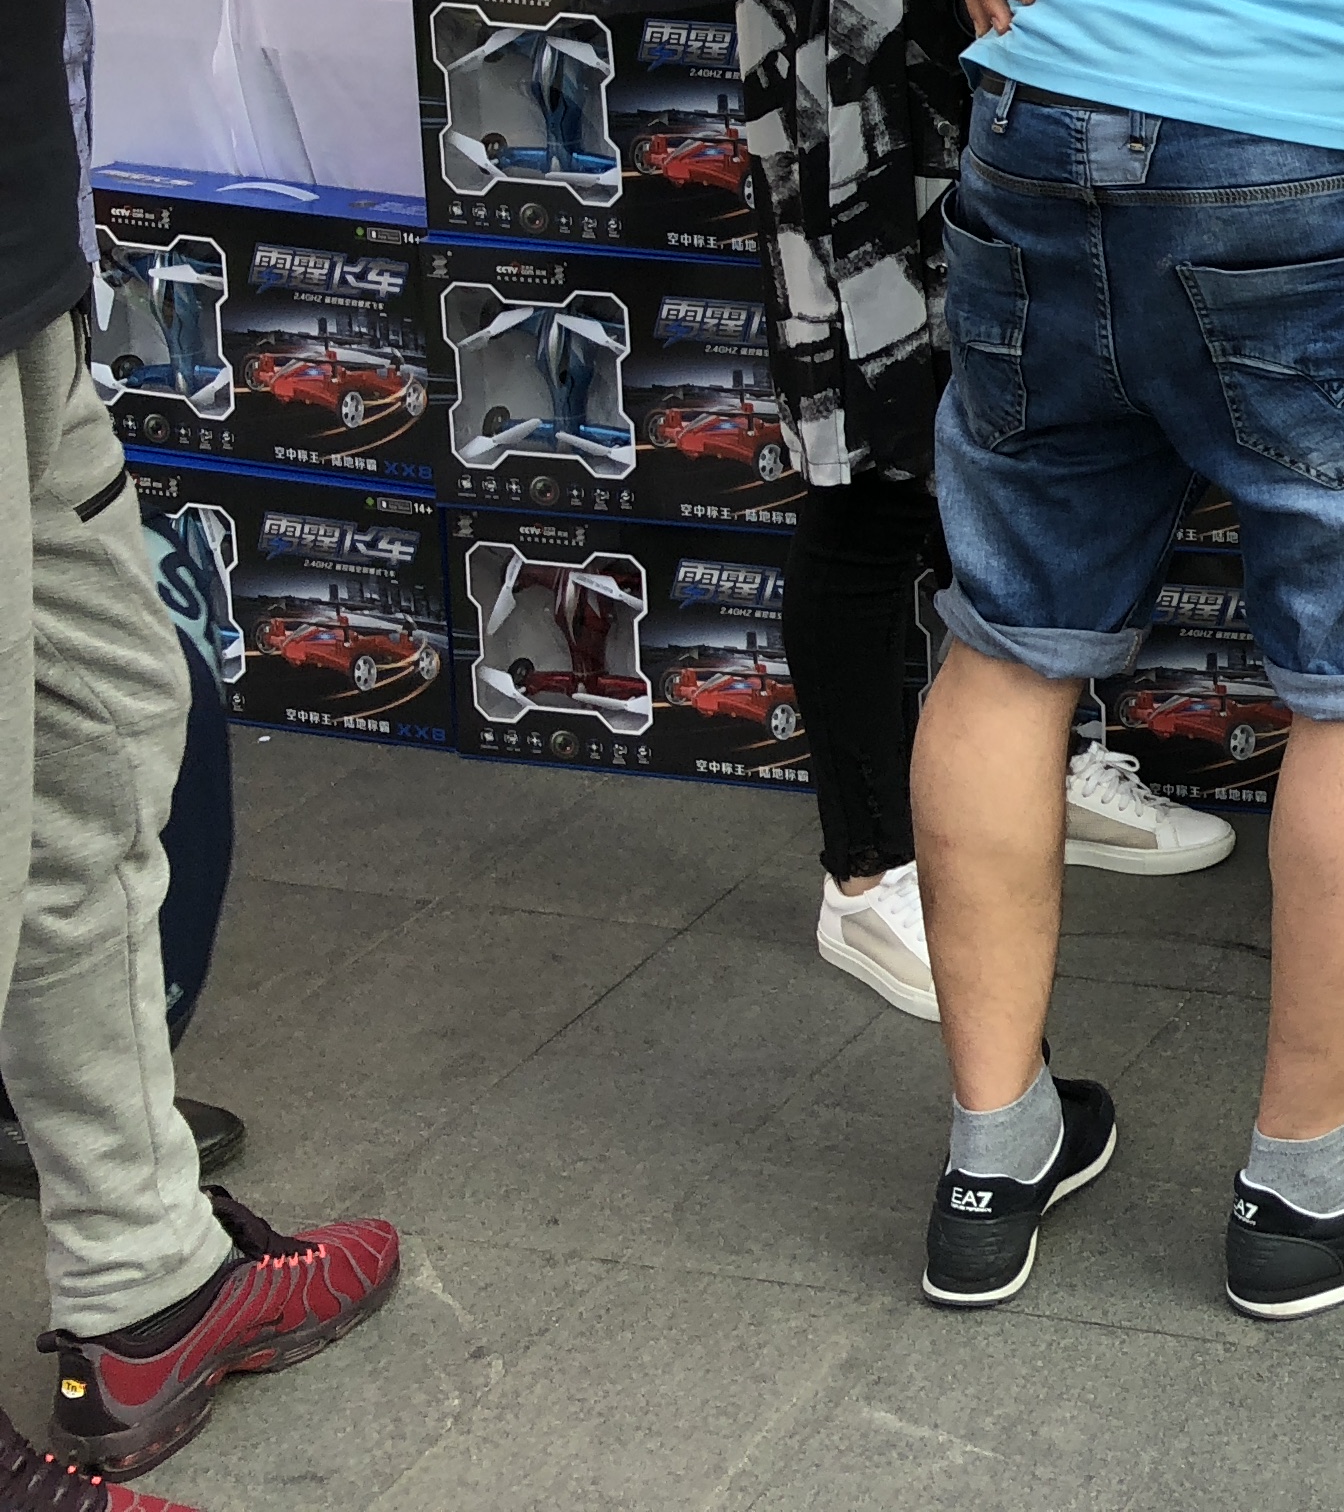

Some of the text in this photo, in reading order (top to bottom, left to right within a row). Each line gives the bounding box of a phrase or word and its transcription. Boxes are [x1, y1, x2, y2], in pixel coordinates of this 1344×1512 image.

[383, 459, 434, 481] XX8
[413, 503, 433, 516] 14+
[396, 721, 447, 743] XX8
[951, 1187, 993, 1205] EA7
